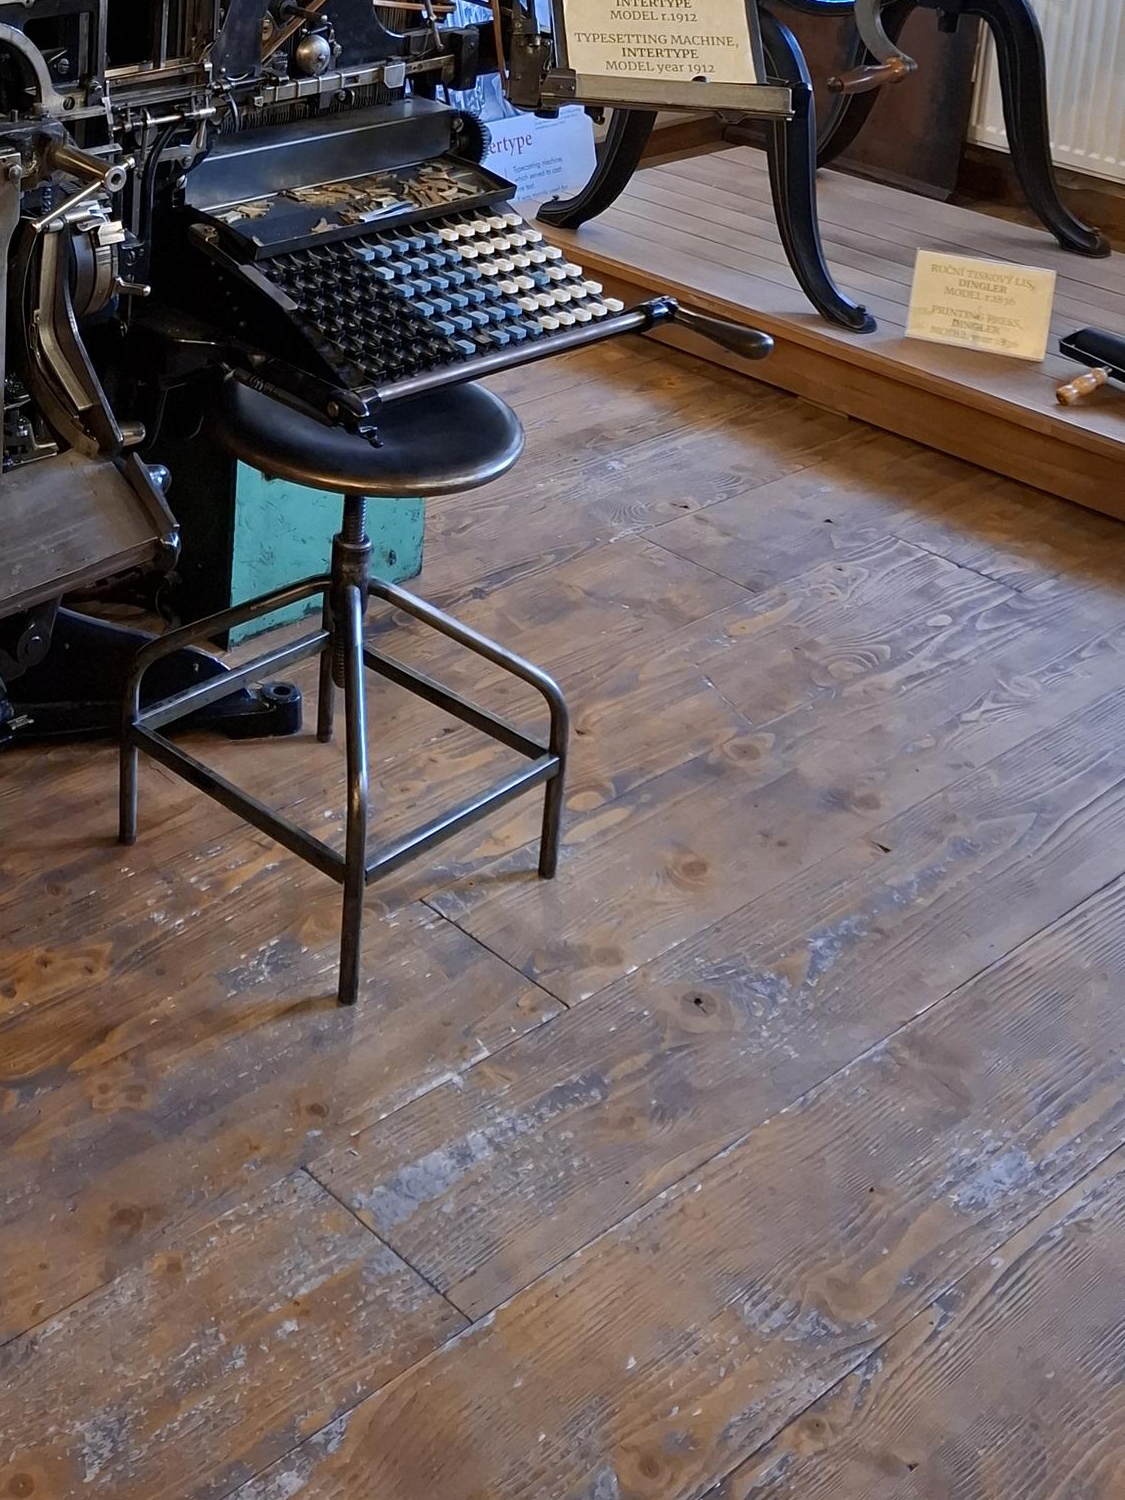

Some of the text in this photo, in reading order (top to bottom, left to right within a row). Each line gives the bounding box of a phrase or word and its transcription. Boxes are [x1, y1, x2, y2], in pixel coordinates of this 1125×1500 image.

[610, 10, 698, 23] MODEL r.1912
[575, 32, 739, 49] TYPESETTING MACHINE,
[621, 47, 699, 59] INTERTYPE
[605, 60, 715, 75] MODEL year 1912
[488, 134, 532, 157] ertype
[931, 263, 1036, 292] RUČNÍ TISKOVÝ LIS,
[944, 286, 982, 301] MODEL
[958, 278, 1007, 294] DINGLER
[931, 305, 985, 321] PRINTING
[930, 326, 967, 340] MODEL
[951, 318, 1000, 334] DINGLER
